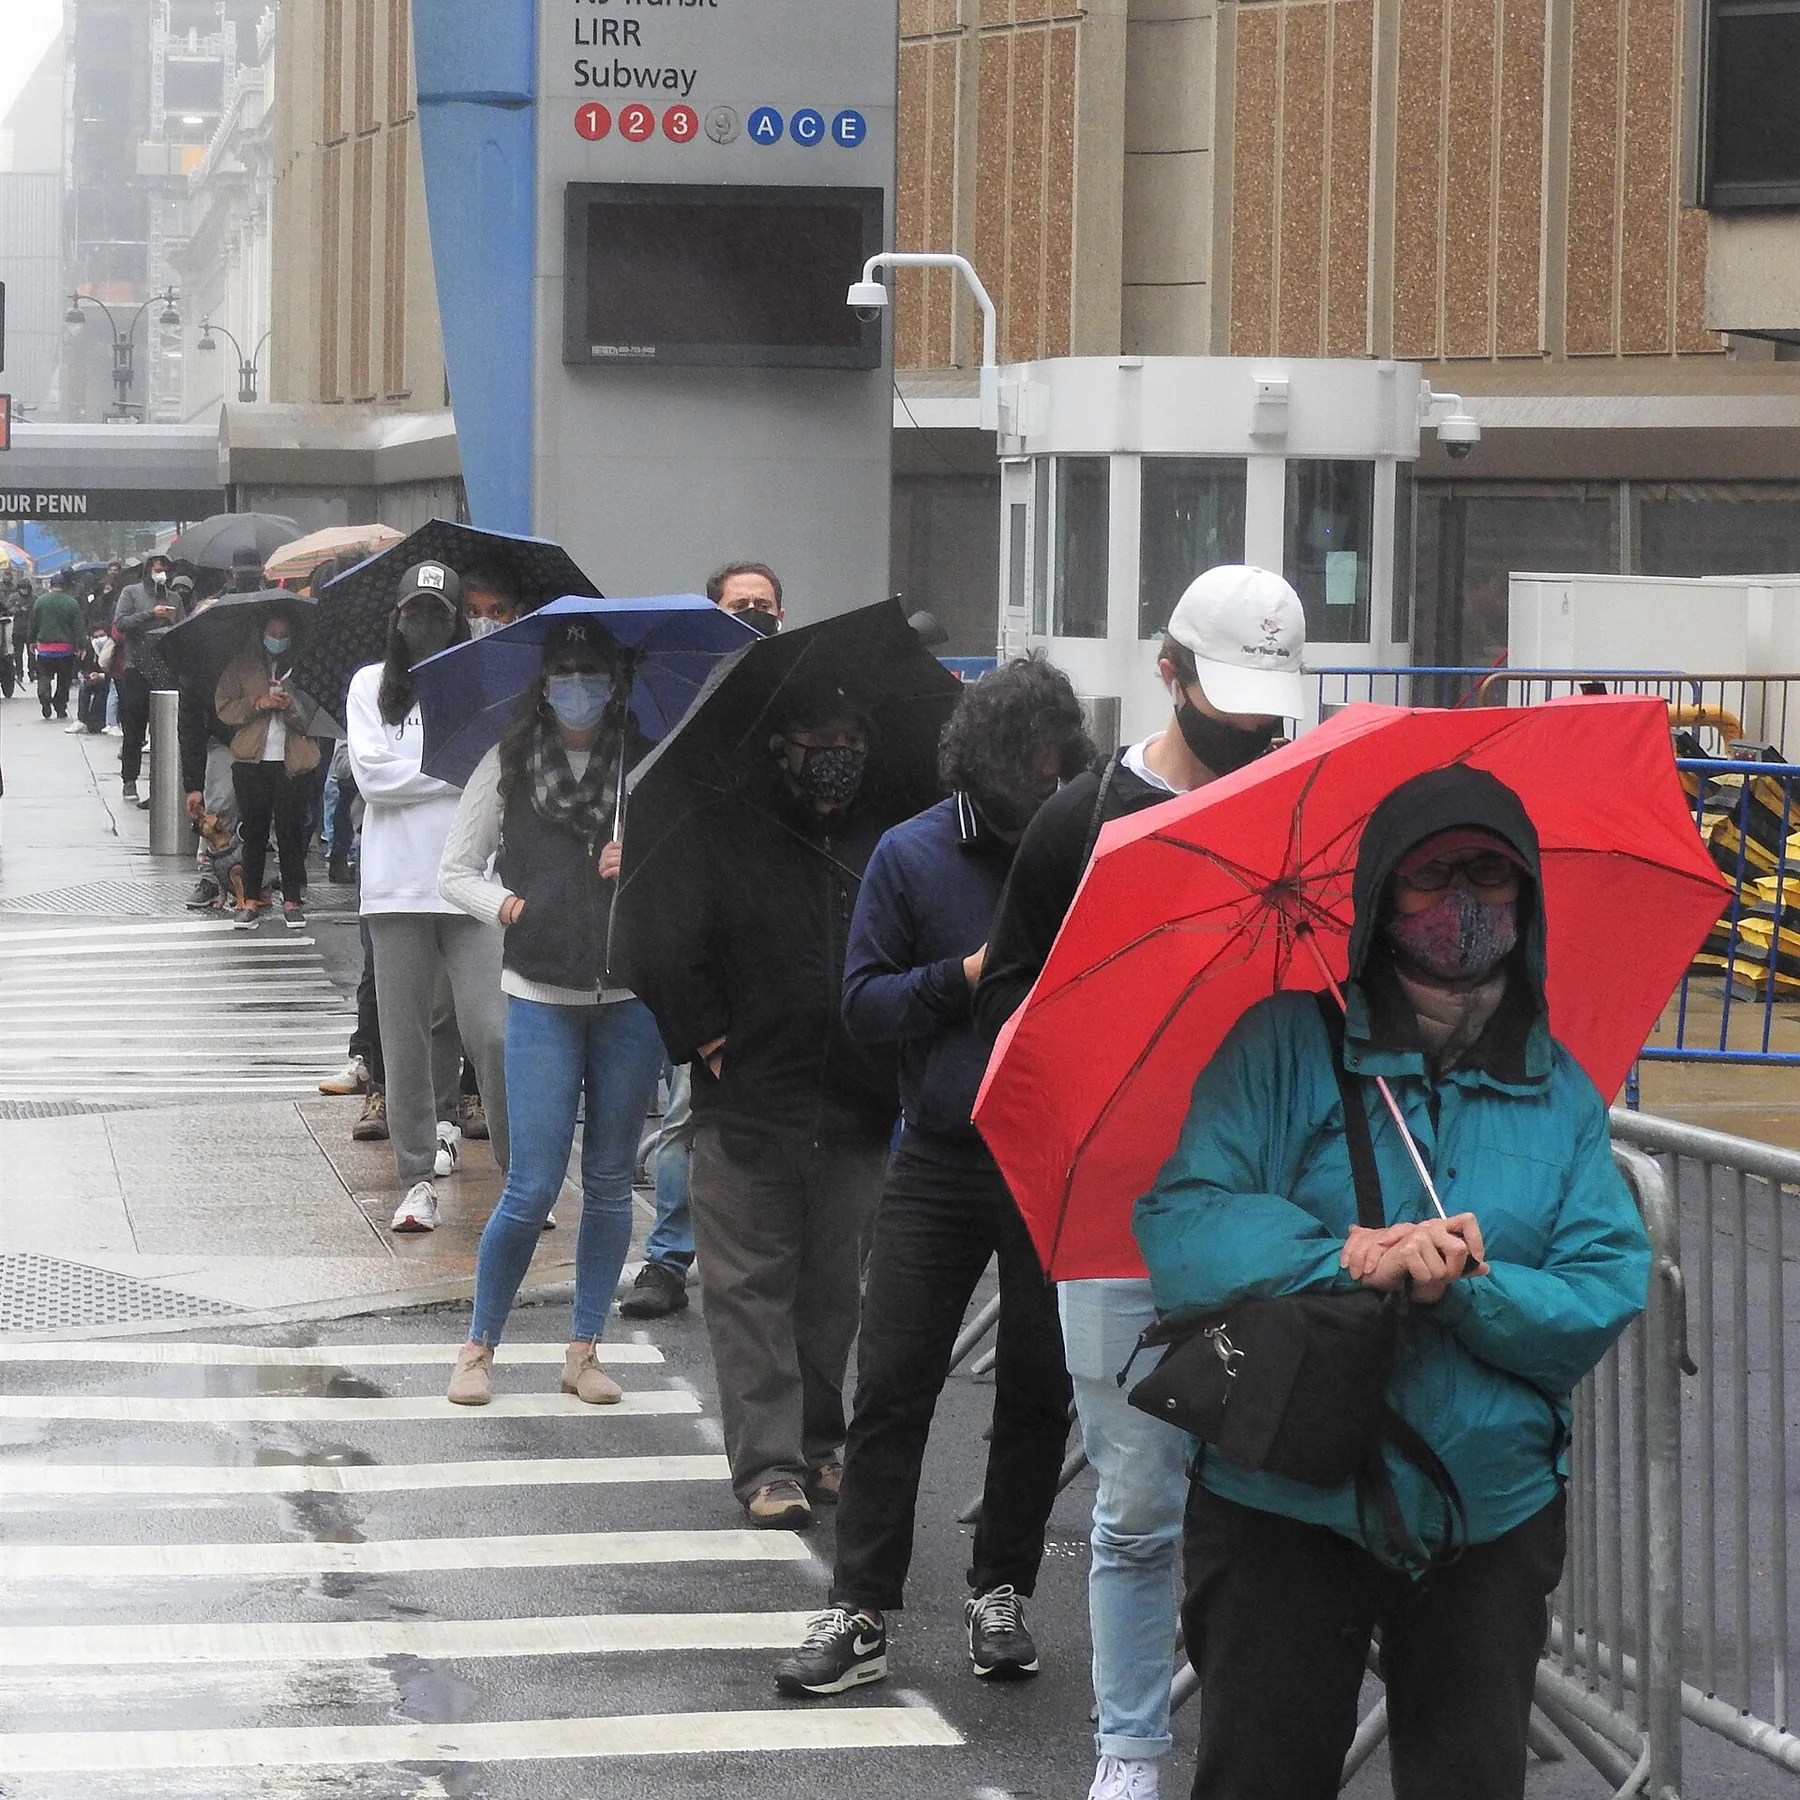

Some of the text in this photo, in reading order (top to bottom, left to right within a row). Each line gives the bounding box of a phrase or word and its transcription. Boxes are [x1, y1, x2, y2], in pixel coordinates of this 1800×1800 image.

[574, 18, 641, 46] LIRR
[574, 58, 697, 97] Subway
[586, 110, 598, 133] 1
[629, 111, 644, 134] 2
[672, 112, 688, 135] 3
[756, 115, 775, 137] A
[798, 116, 816, 138] C
[841, 118, 856, 139] E
[36, 494, 87, 513] PENN
